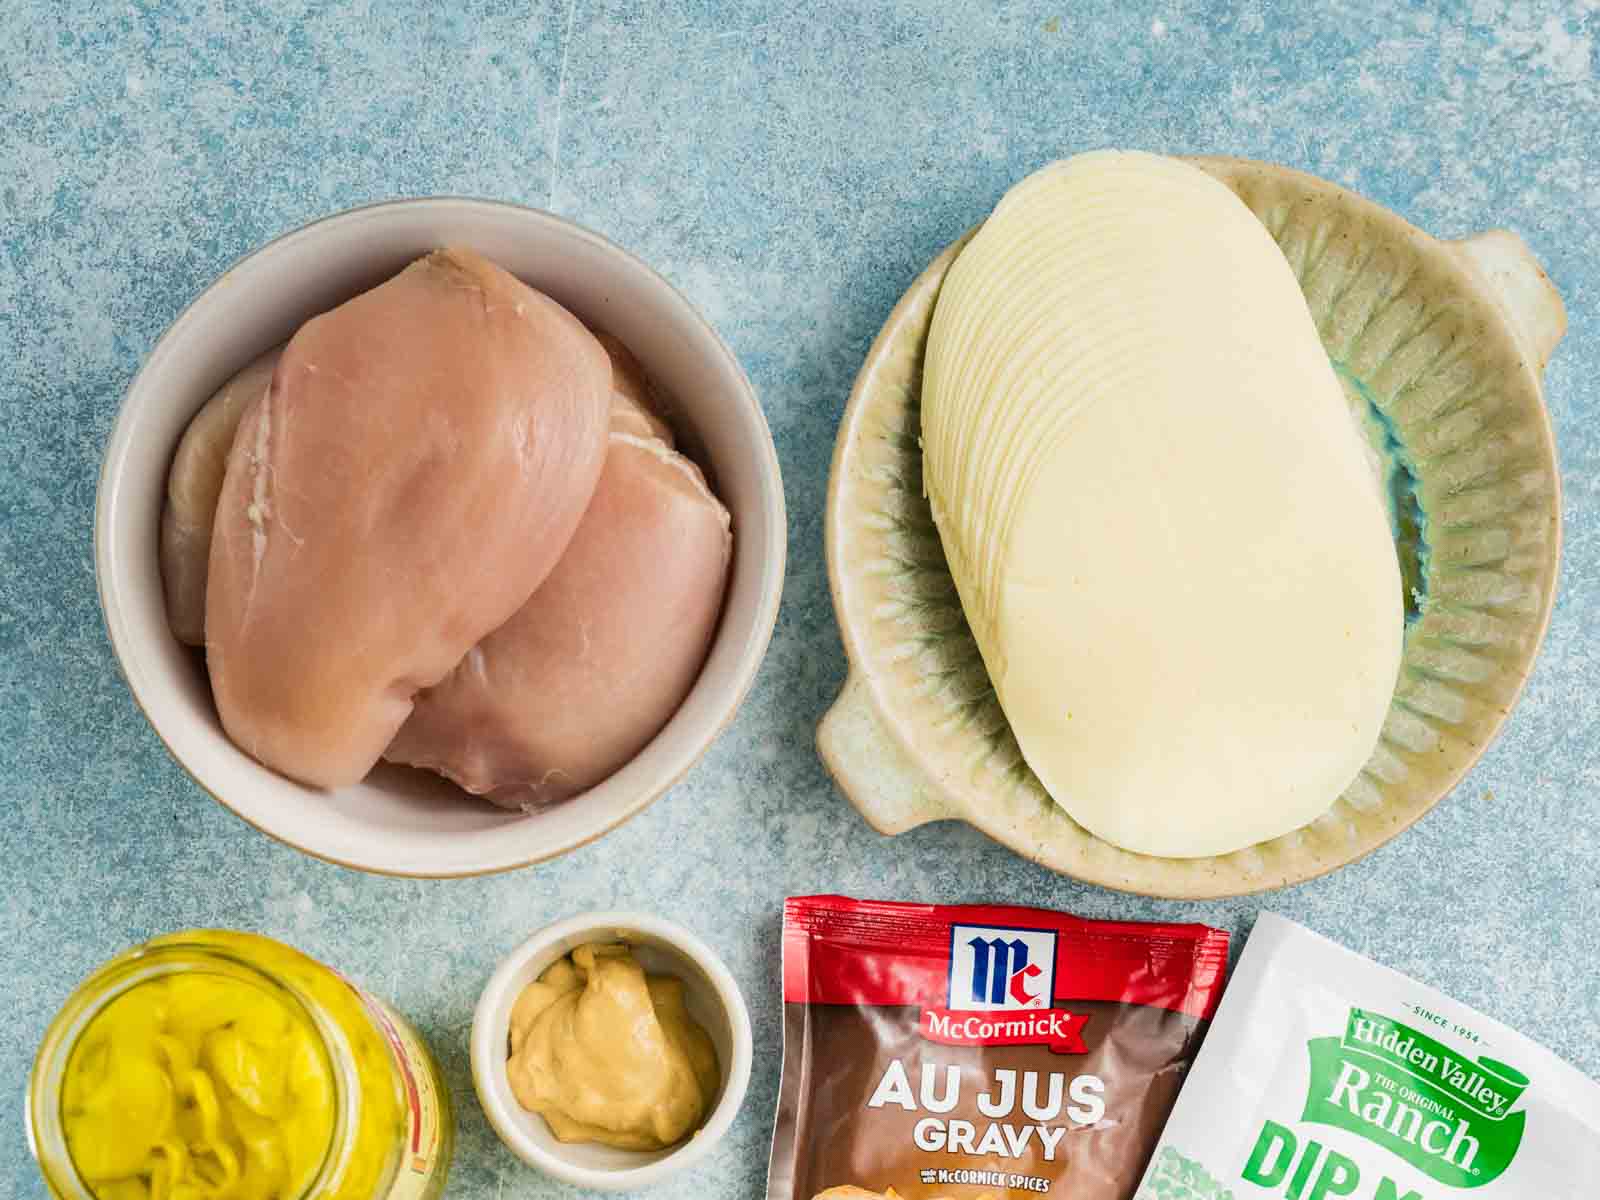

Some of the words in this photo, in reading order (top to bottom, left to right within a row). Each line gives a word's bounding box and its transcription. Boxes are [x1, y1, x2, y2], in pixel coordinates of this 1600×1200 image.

[926, 1011, 1067, 1039] McCormick
[1413, 1006, 1447, 1029] SINCE
[1452, 1024, 1479, 1045] 1954
[1351, 1017, 1438, 1073] Hidden
[1442, 1054, 1509, 1116] Valley
[868, 1059, 963, 1114] AU
[976, 1070, 1105, 1125] JUS
[1375, 1072, 1399, 1091] THE
[1400, 1087, 1455, 1121] ORIGINAL
[1328, 1060, 1482, 1172] Ranch
[914, 1118, 1066, 1161] GRAVY
[938, 1169, 1006, 1187] McCORMICK
[1009, 1174, 1051, 1193] SPICES
